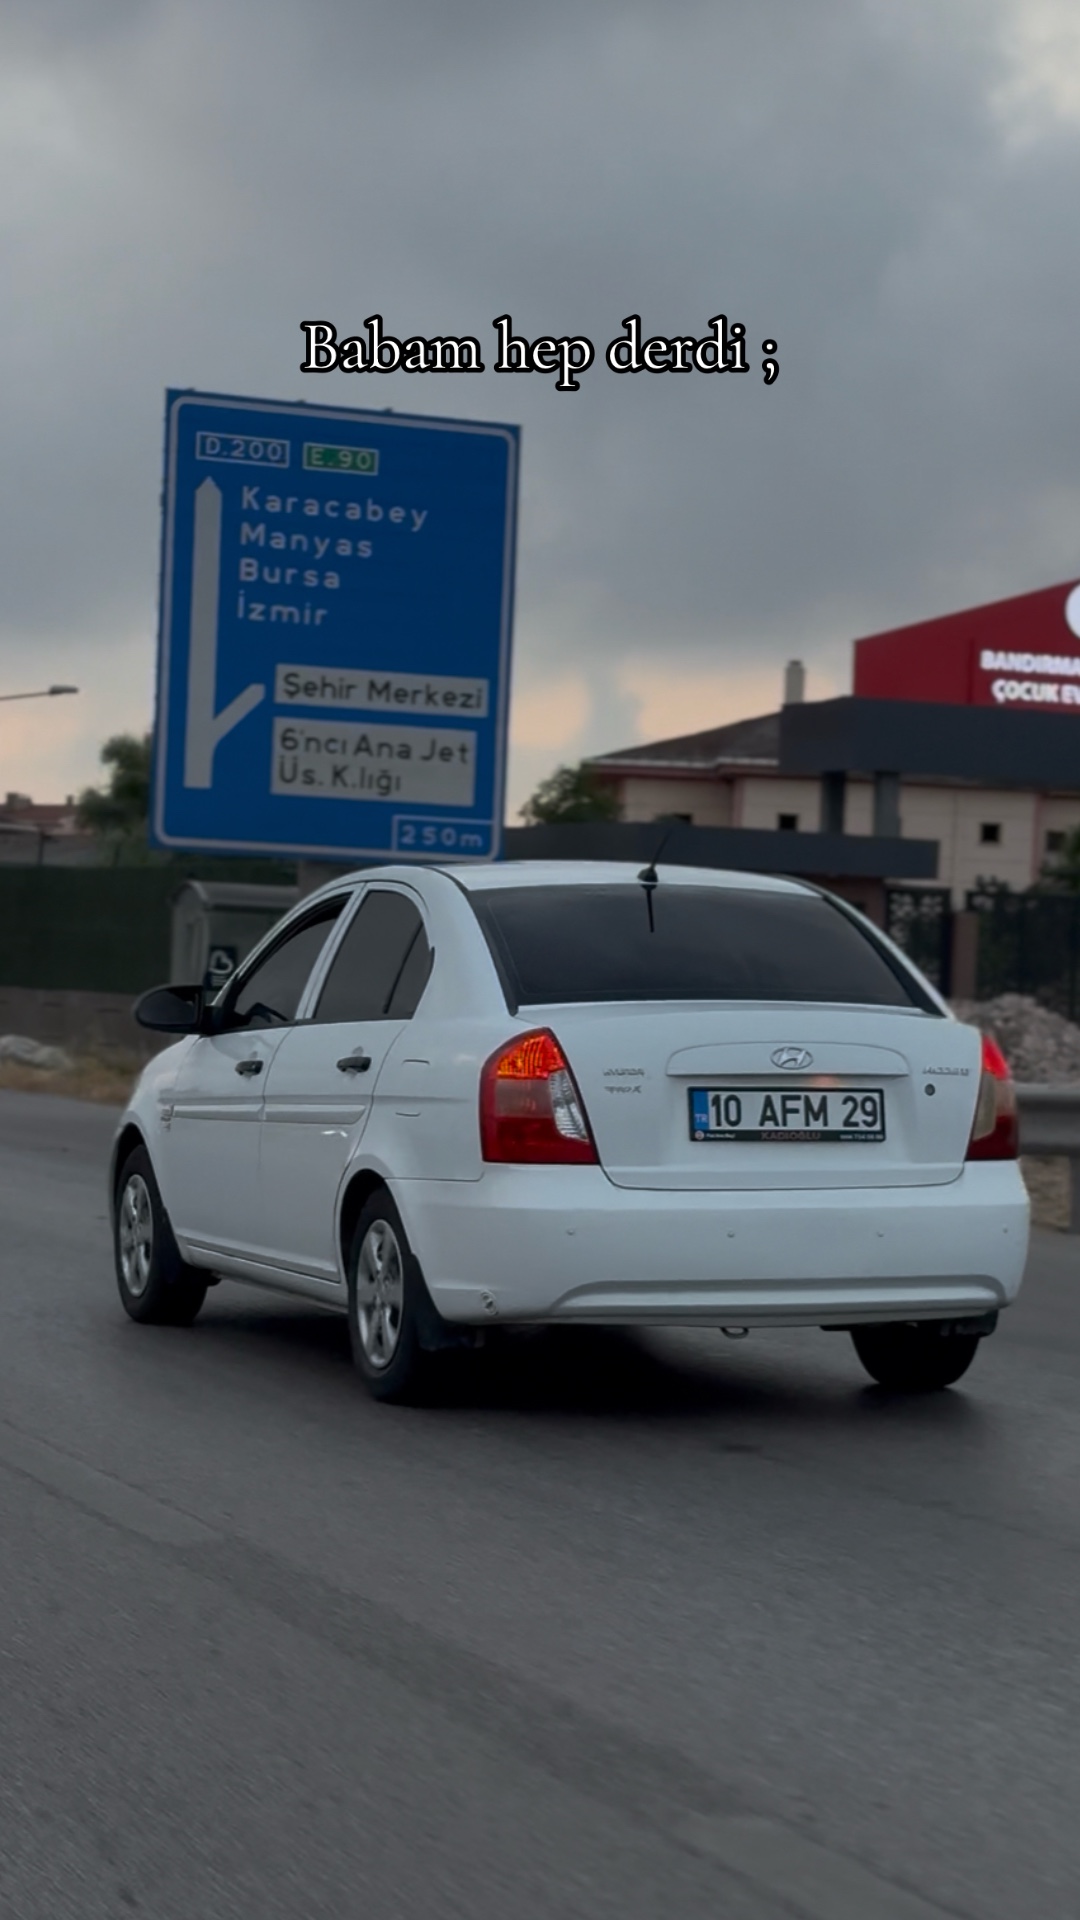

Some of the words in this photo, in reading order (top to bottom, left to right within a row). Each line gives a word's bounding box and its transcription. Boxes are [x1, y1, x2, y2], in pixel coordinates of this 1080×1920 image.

[205, 437, 282, 461] D.200
[311, 448, 372, 470] E.90
[242, 486, 428, 532] Karacabey
[240, 522, 373, 559] Manyas
[239, 557, 341, 589] Bursa
[237, 590, 328, 626] İzmir
[283, 672, 357, 699] Şehir
[367, 679, 483, 709] Merkezi
[991, 678, 1060, 704] ÇOCUK
[353, 734, 412, 760] Ana
[420, 737, 469, 765] Jet
[278, 755, 324, 787] Üs.
[331, 764, 402, 797] K.lığı
[400, 825, 483, 848] 250m
[711, 1094, 742, 1127] 10
[759, 1094, 828, 1127] AFM
[841, 1095, 878, 1128] 29
